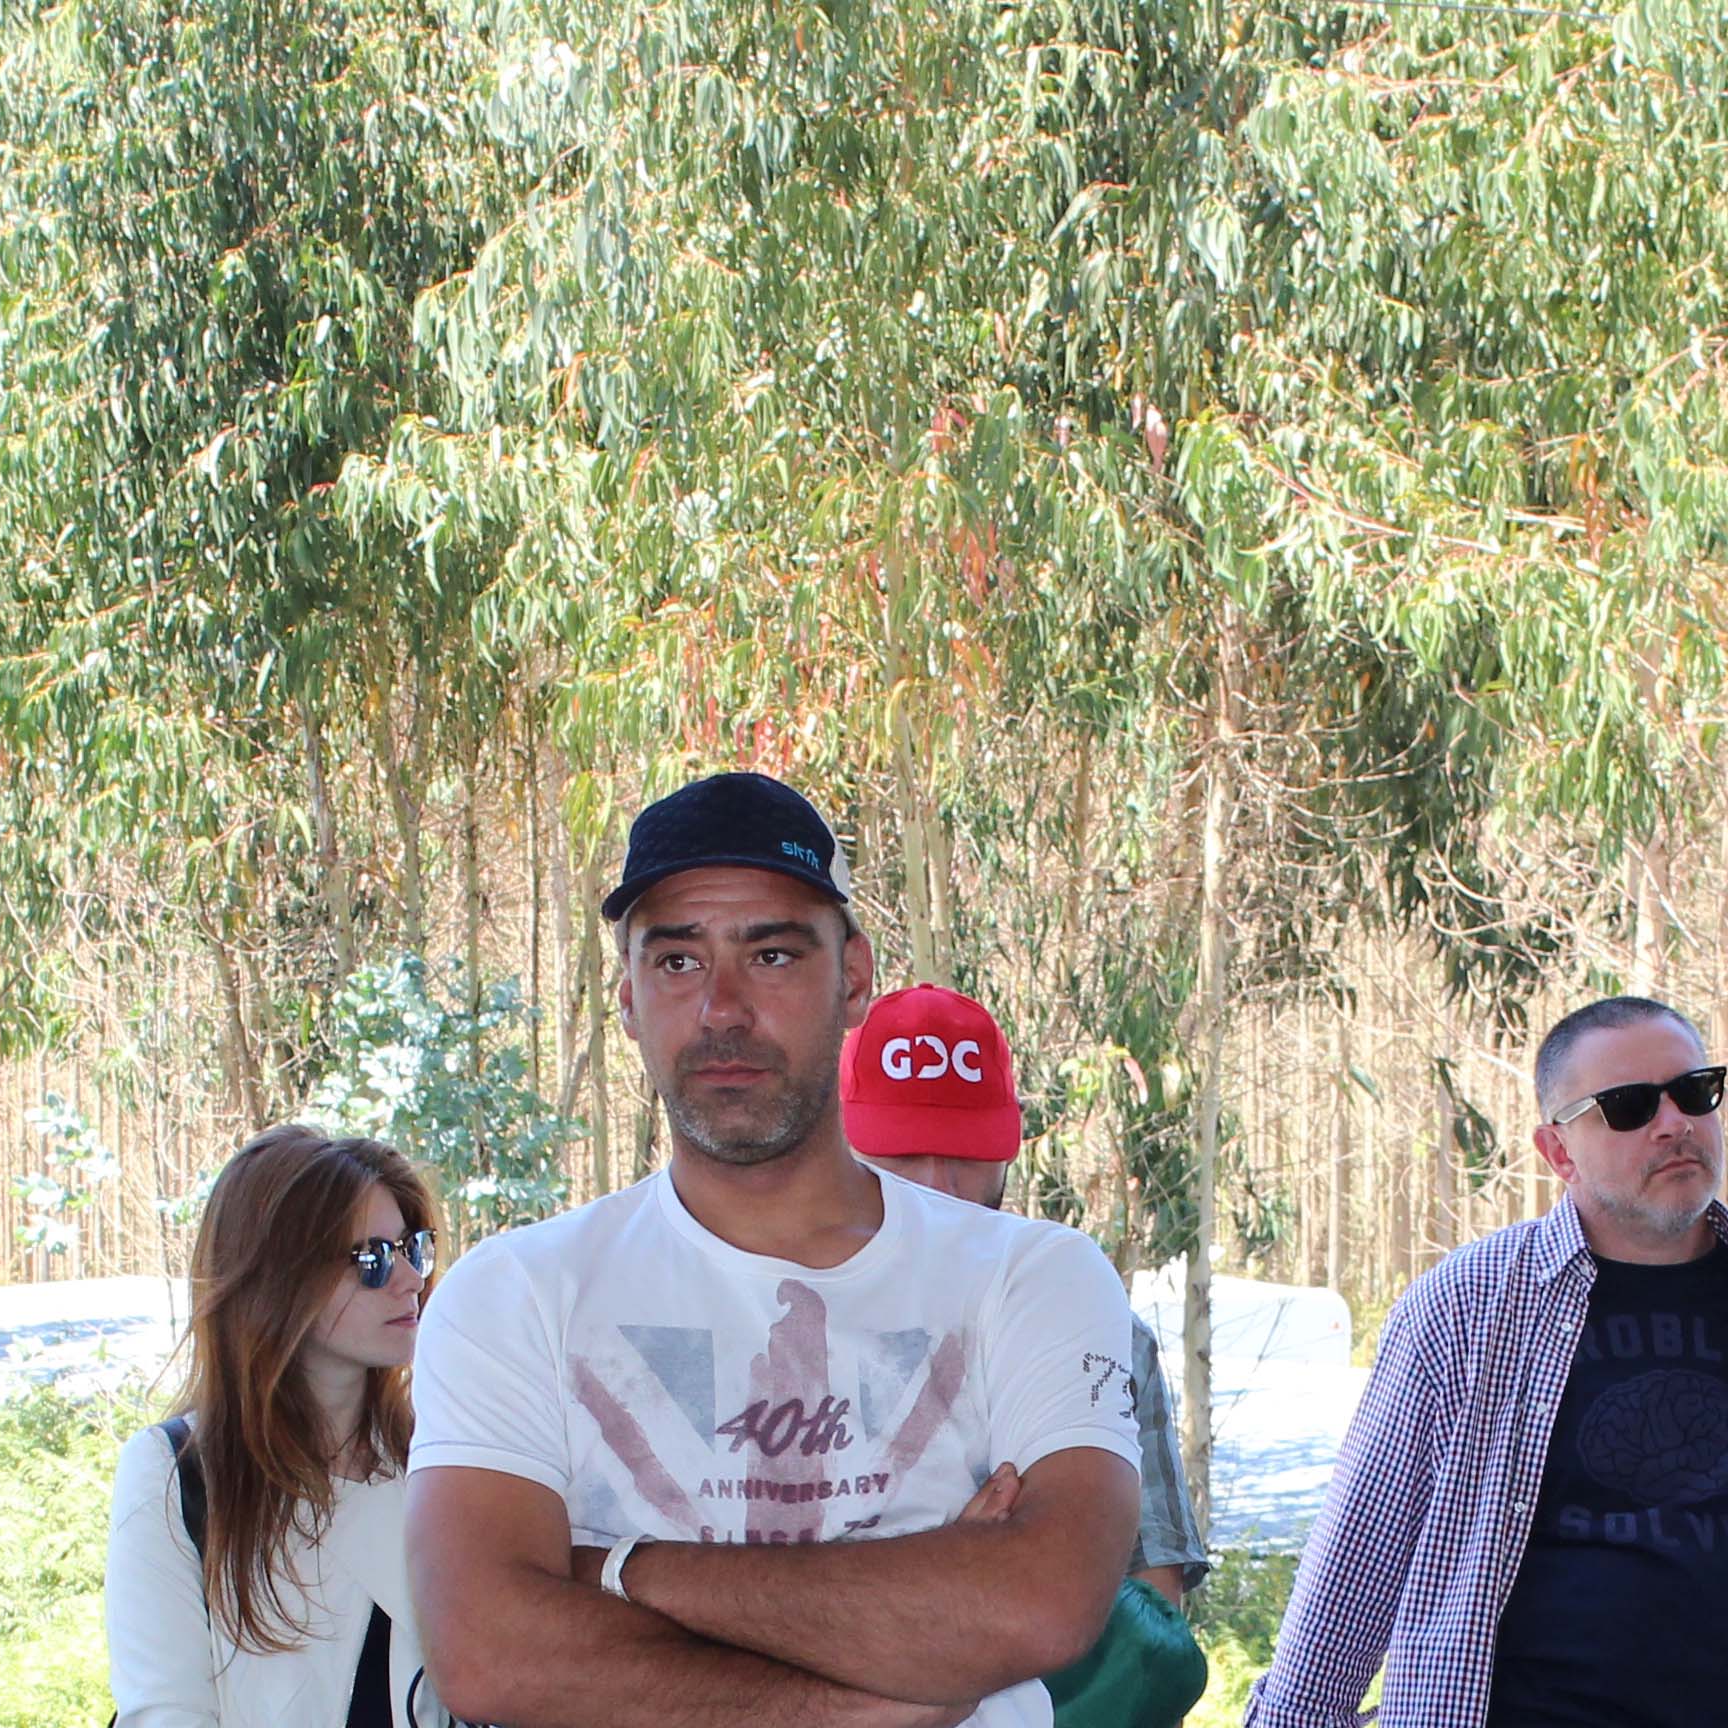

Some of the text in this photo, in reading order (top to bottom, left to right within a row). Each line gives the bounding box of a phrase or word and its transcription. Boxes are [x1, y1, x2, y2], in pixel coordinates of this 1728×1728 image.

[882, 1034, 985, 1083] GDC
[716, 1394, 855, 1458] 40th
[698, 1472, 890, 1504] ANNIVERSARY
